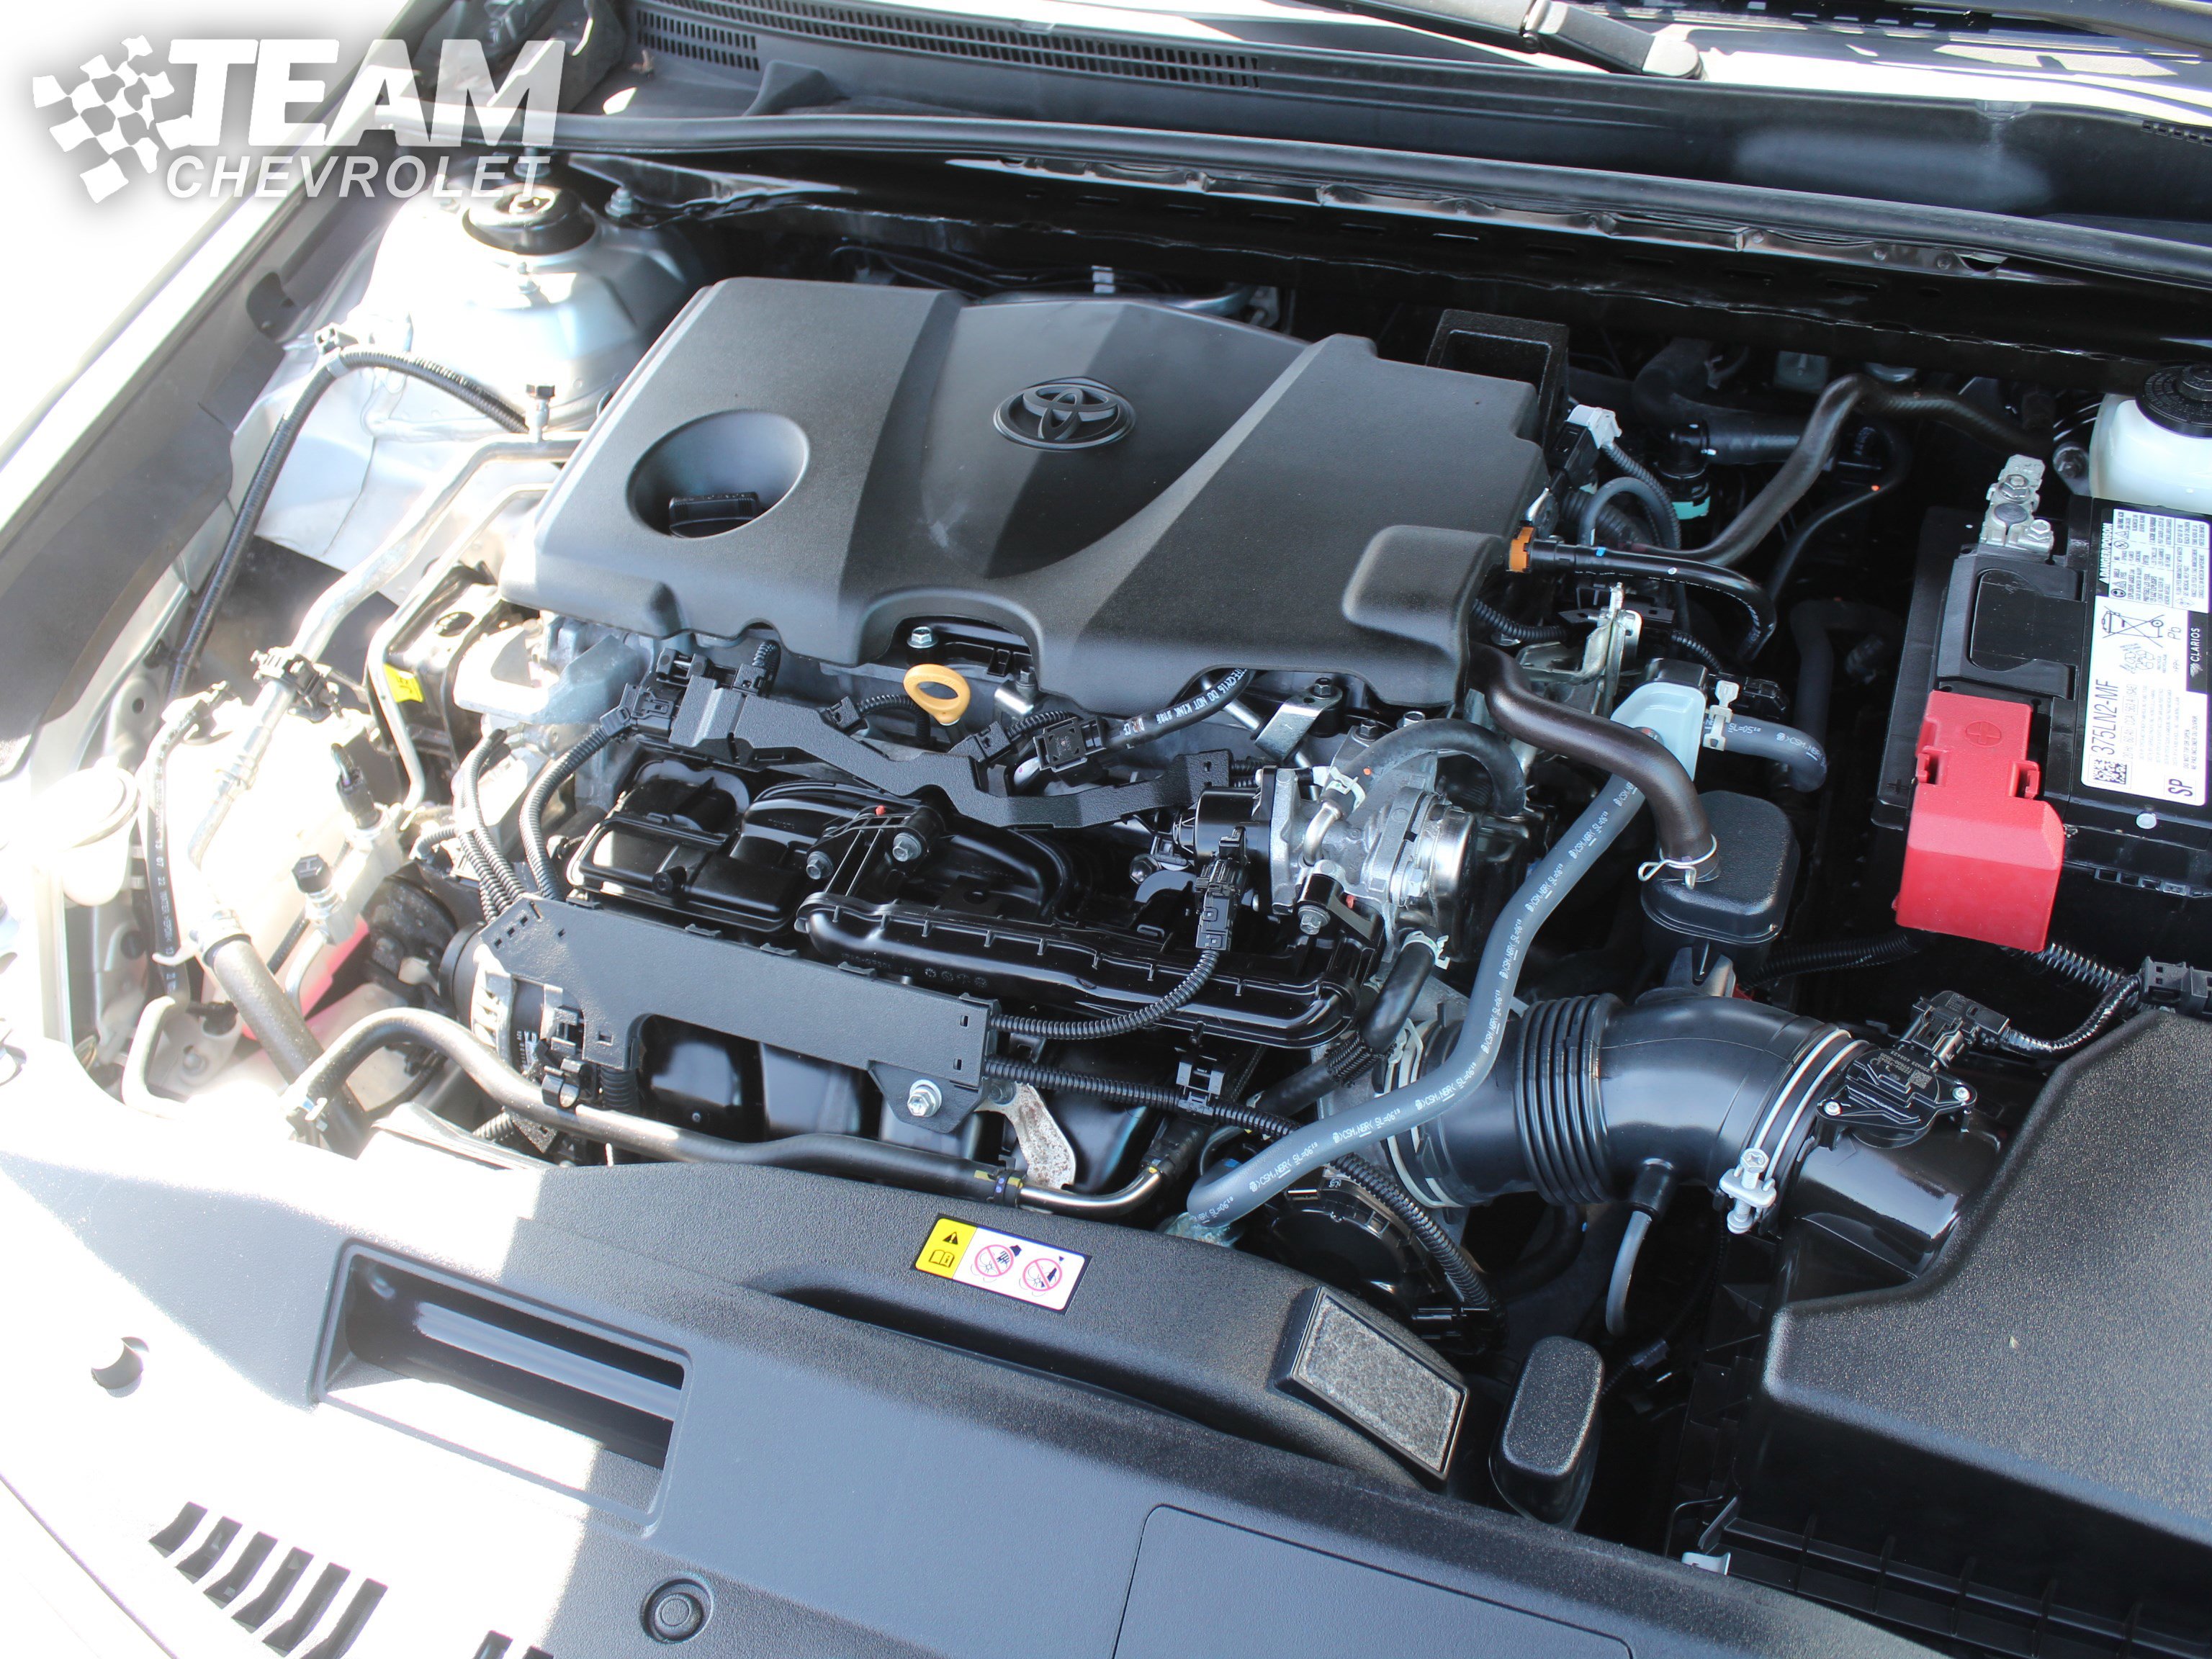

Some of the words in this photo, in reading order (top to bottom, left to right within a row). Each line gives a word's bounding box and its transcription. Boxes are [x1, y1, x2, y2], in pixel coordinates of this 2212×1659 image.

[2098, 522, 2113, 578] DANGER/POISON
[2167, 625, 2181, 640] Pb
[2189, 626, 2200, 662] CLARIOS
[1174, 702, 1192, 718] KINK
[1192, 696, 1208, 711] NOT
[2090, 678, 2119, 755] 375LN2-MF
[2167, 777, 2193, 798] SP
[156, 876, 166, 886] 22
[158, 889, 169, 914] WATER
